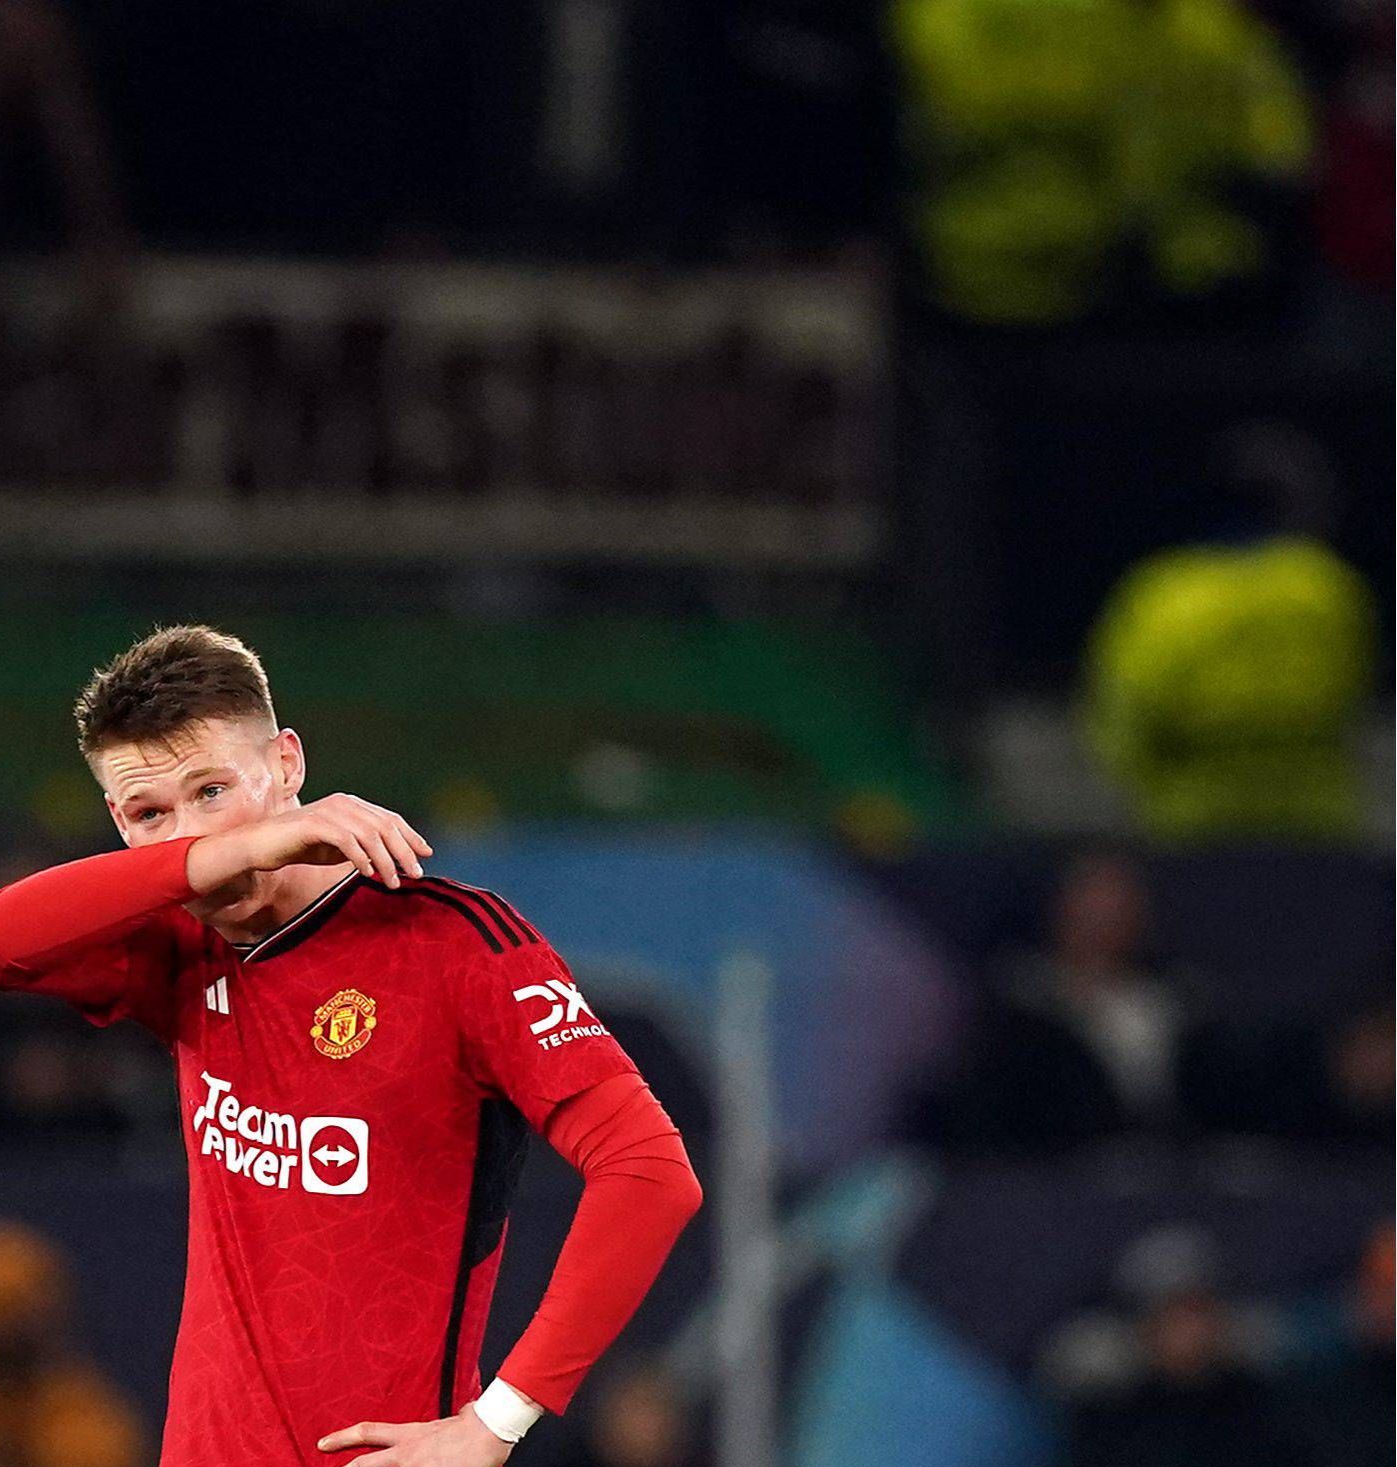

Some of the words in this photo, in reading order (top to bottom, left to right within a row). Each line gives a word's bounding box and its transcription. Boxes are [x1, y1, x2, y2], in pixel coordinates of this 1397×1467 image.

[513, 979, 597, 1036] DX
[537, 1024, 611, 1051] TECHNOL
[199, 1070, 298, 1151] Team
